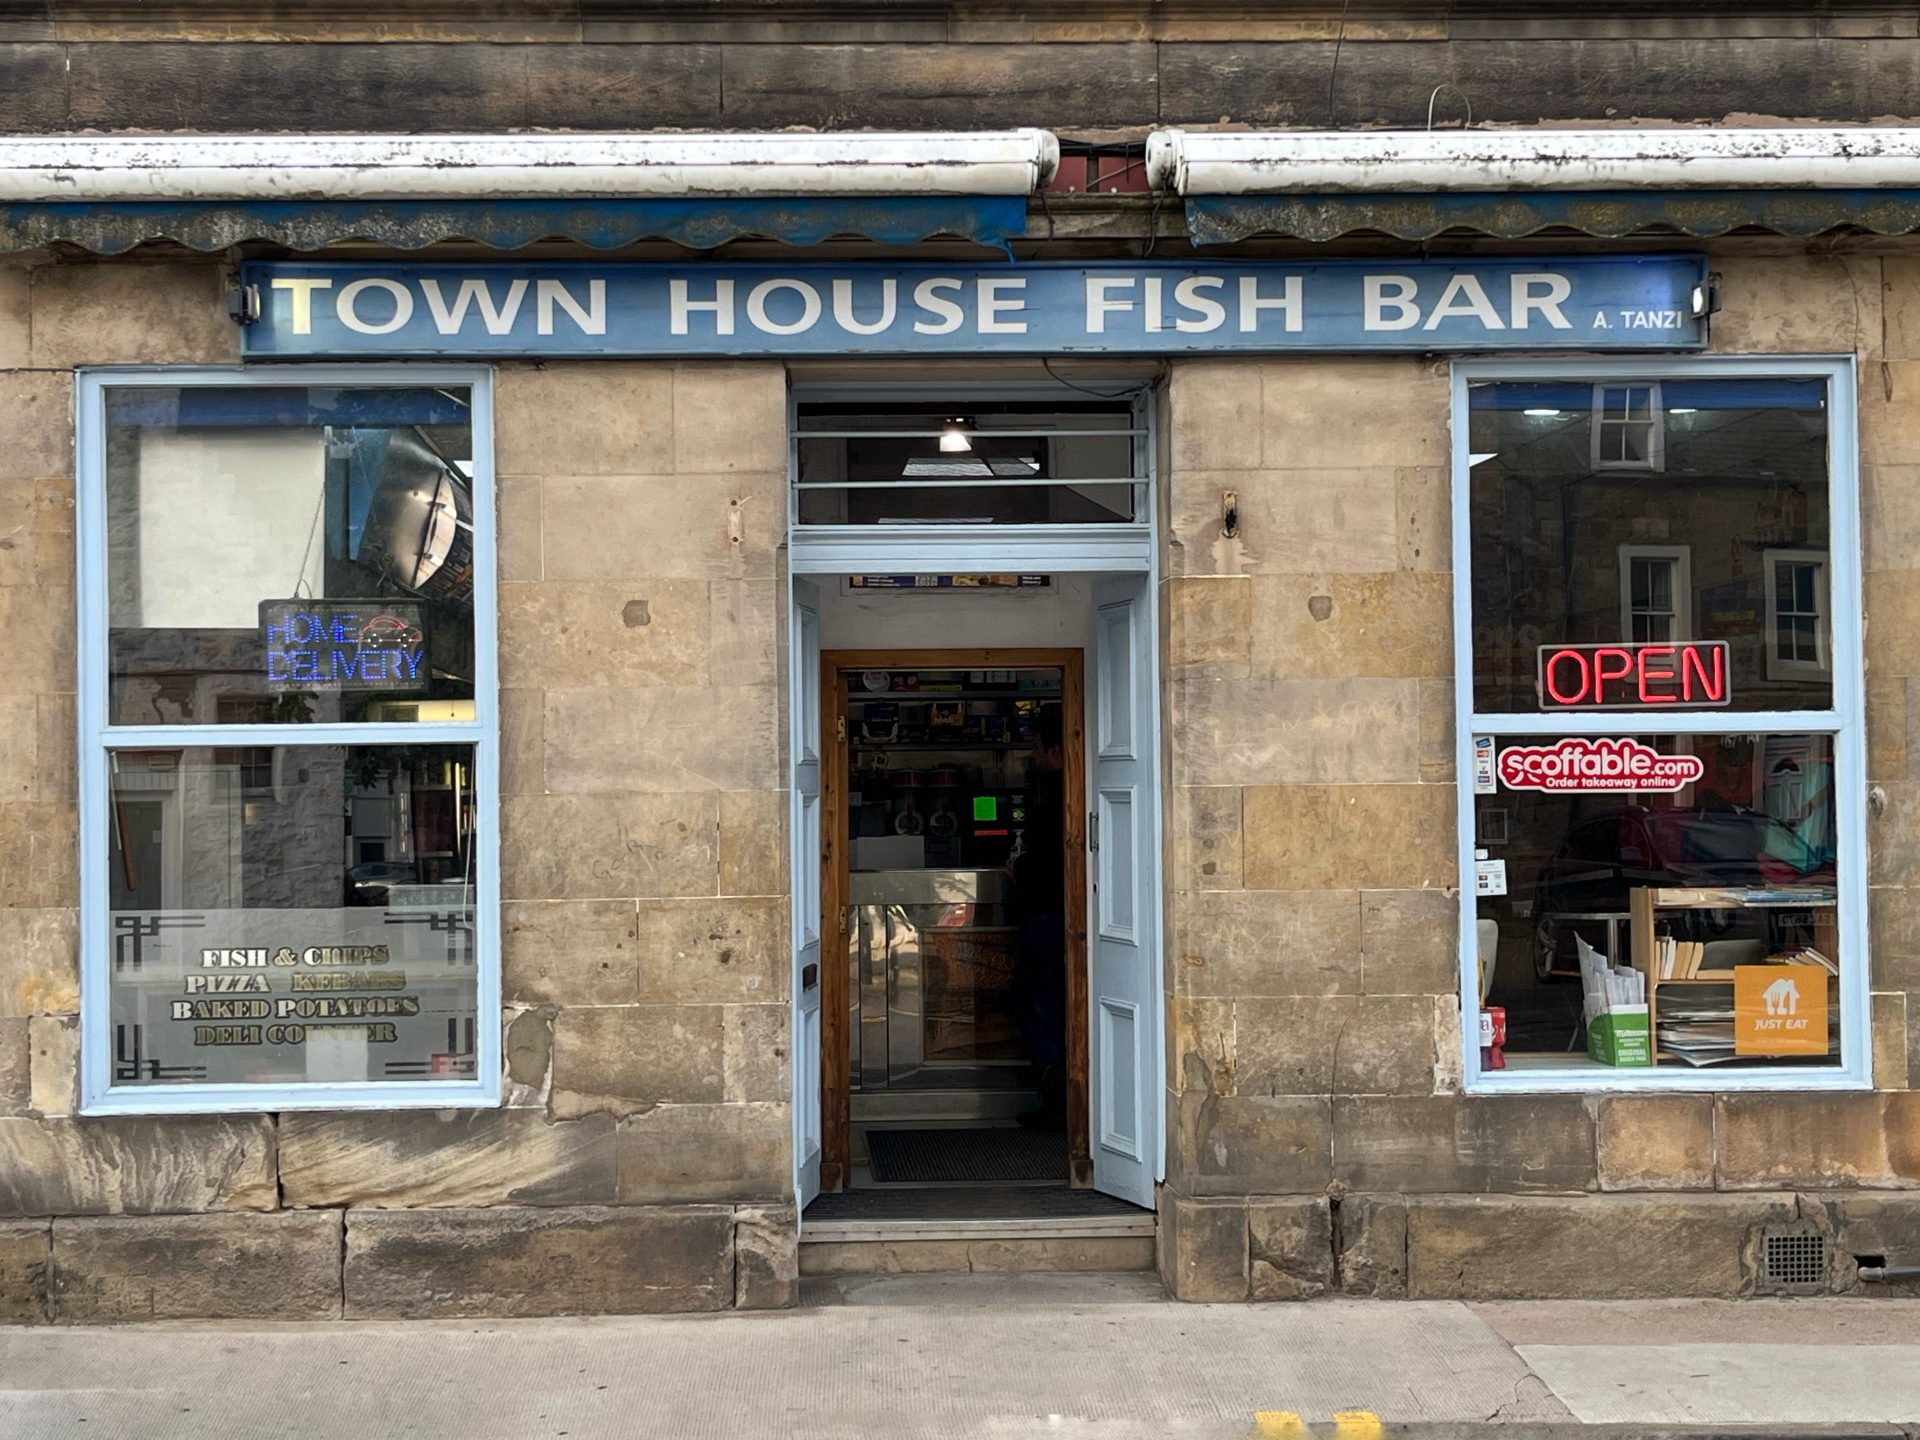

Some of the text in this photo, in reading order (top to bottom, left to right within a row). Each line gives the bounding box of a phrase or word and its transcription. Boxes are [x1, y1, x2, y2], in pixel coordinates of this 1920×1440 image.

[271, 274, 1573, 337] TOWN HOUSE FISH BAR
[1592, 310, 1682, 329] A. TANZI
[267, 613, 359, 644] HOME
[267, 649, 424, 681] DELIVERY
[1546, 646, 1722, 705] OPEN
[1506, 746, 1696, 777] scoffable.com
[1546, 776, 1677, 789] Order takeaway online
[202, 945, 390, 968] FISH & CHIPS
[184, 974, 271, 994] PIZZA
[171, 997, 420, 1020] BAKED POTATOES
[194, 1025, 263, 1046] DELI
[1754, 1019, 1809, 1031] JUST EAT
